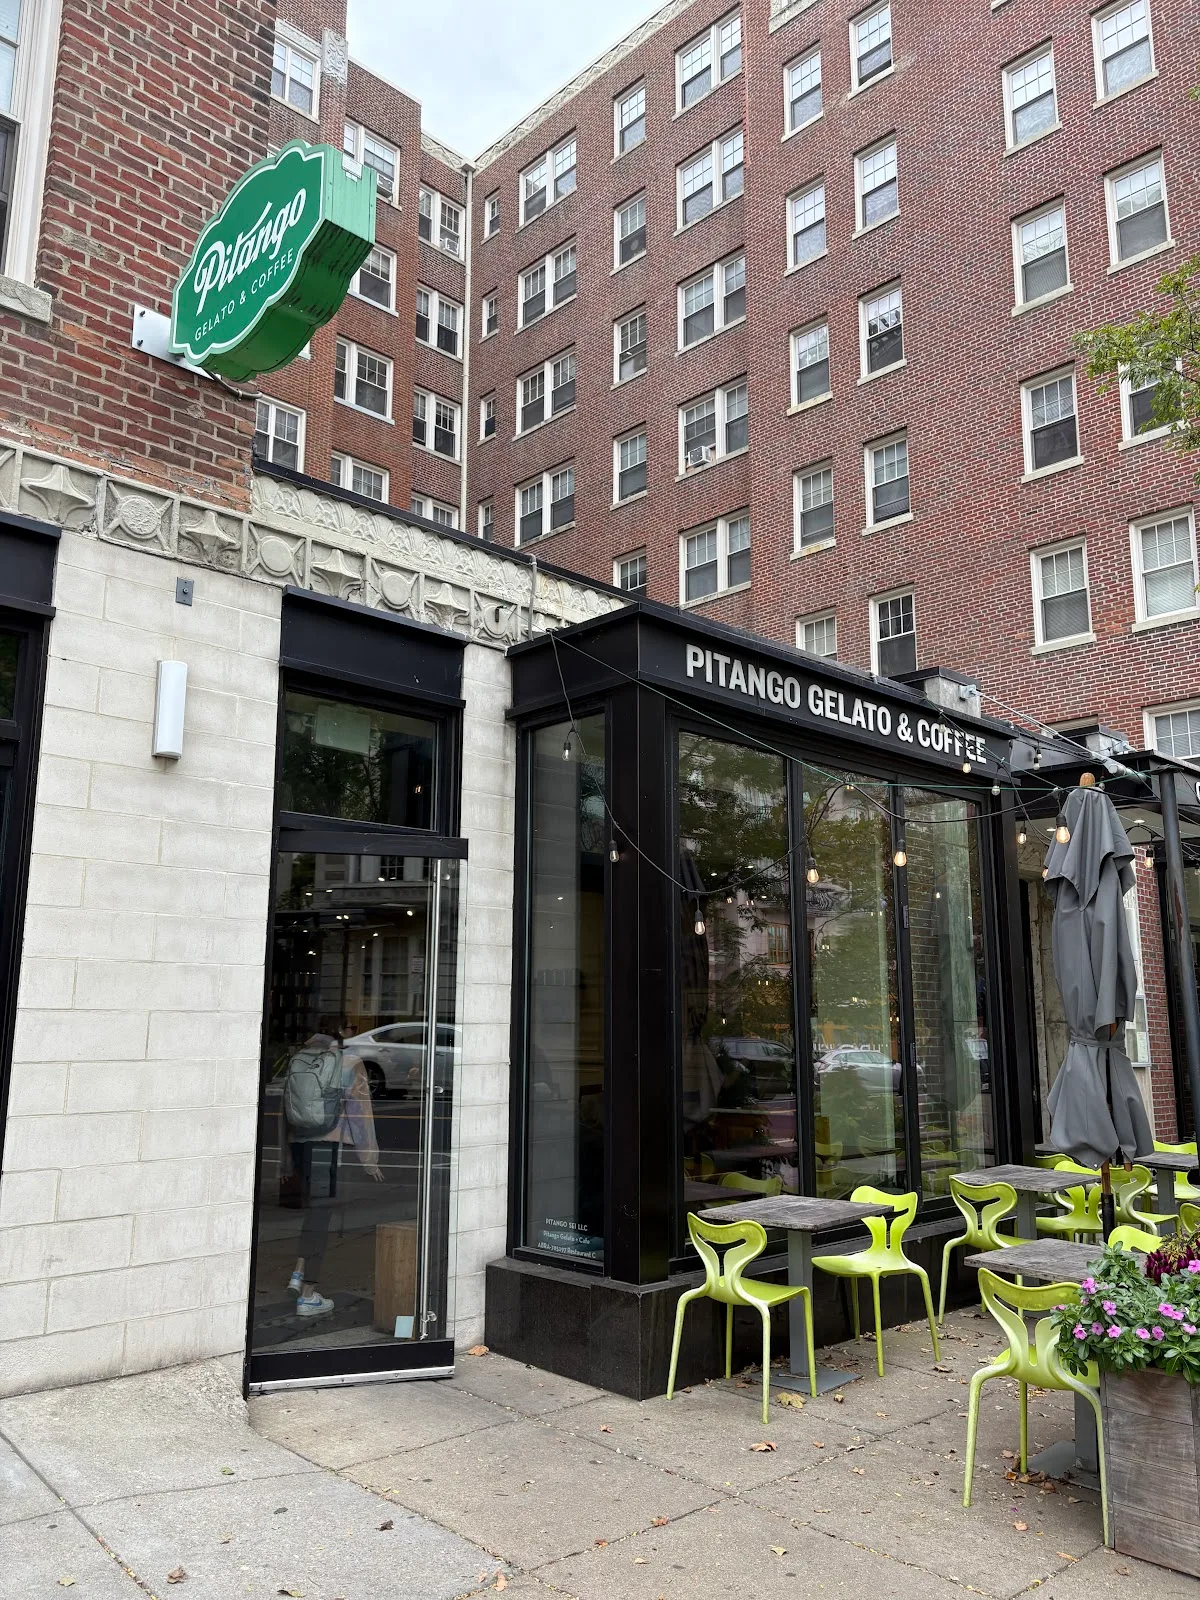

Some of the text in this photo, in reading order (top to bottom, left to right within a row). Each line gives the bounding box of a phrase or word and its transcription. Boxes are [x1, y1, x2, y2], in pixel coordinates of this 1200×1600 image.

[193, 188, 306, 316] Pitango
[194, 248, 294, 341] GELATO & COFFEE
[686, 643, 987, 764] PITANGO GELATO & COFFEE
[543, 1230, 559, 1240] Pitango
[559, 1233, 575, 1242] Gelato
[545, 1218, 567, 1228] PITANGO
[577, 1223, 588, 1231] LLC
